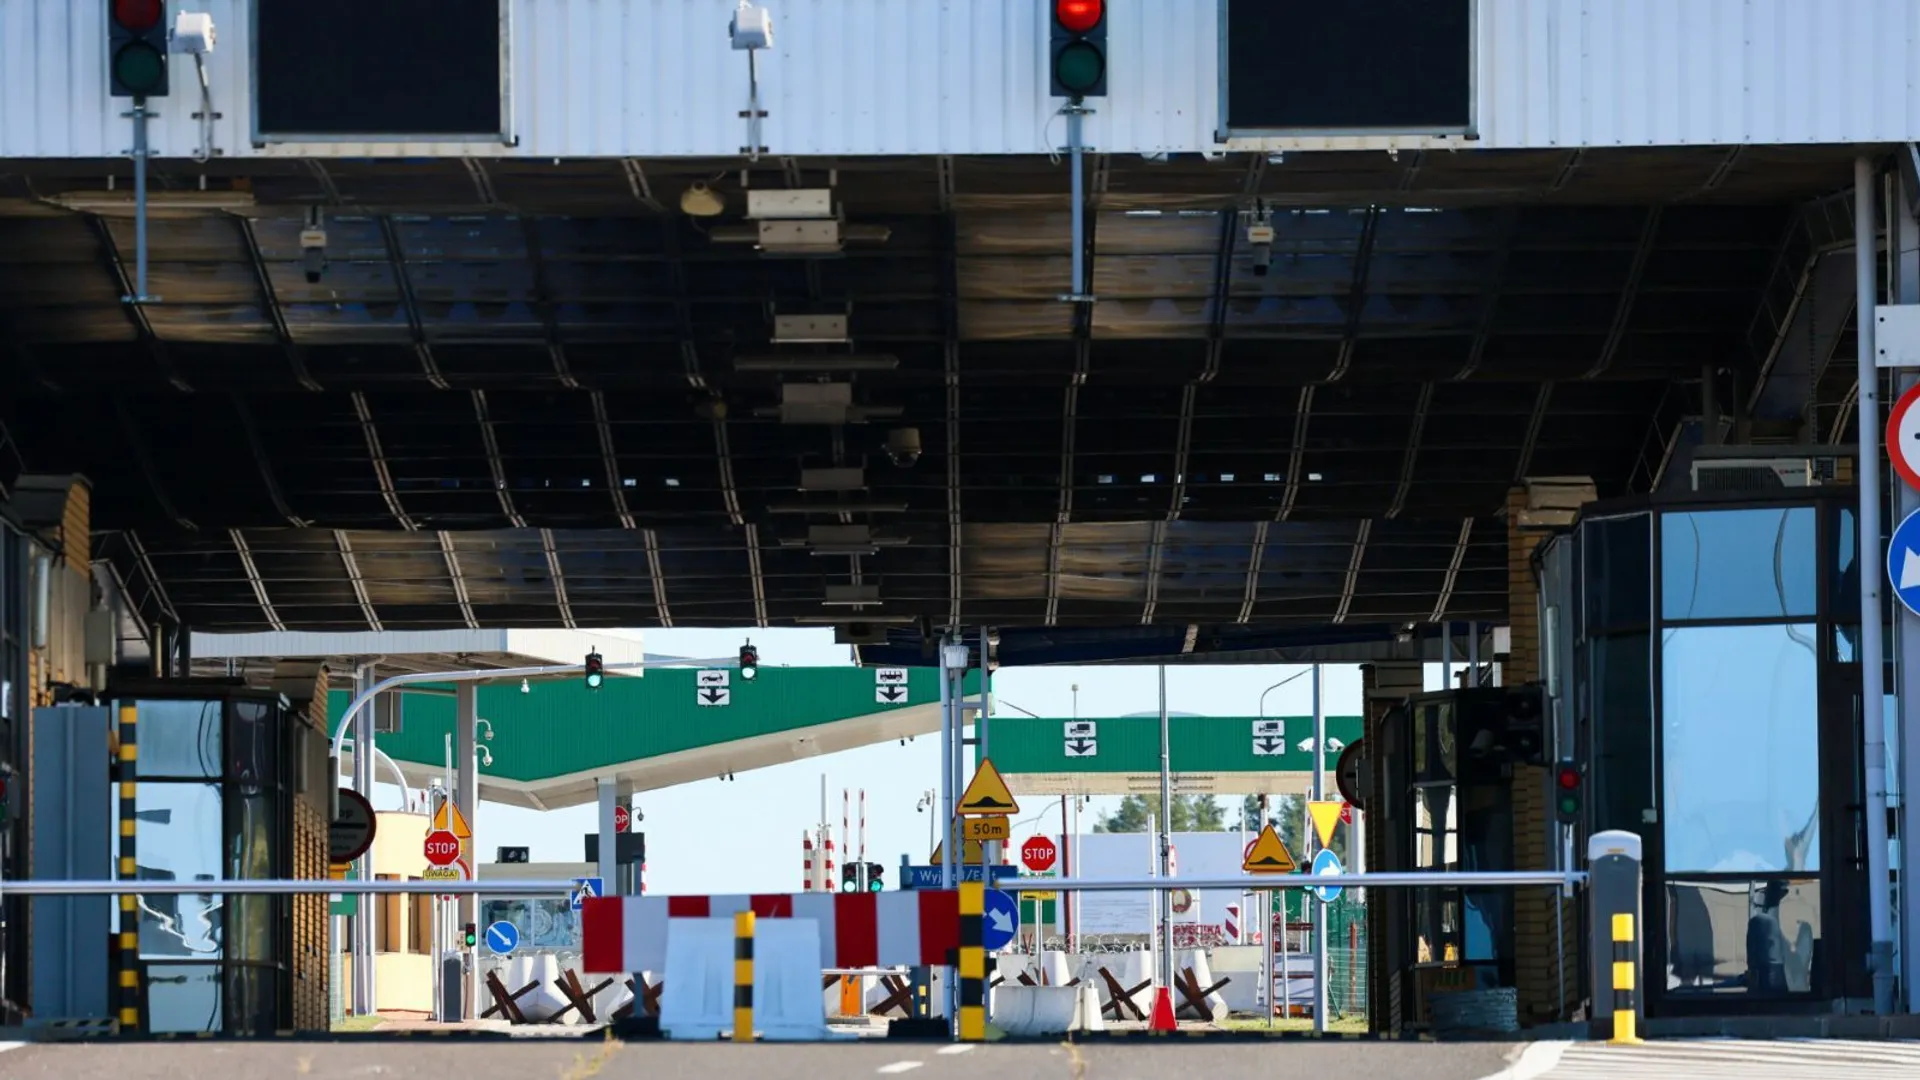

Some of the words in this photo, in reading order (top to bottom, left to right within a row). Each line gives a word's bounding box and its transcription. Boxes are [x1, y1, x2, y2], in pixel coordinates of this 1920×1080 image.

[615, 814, 628, 824] OP
[427, 842, 457, 855] STOP
[1024, 848, 1054, 860] STOP
